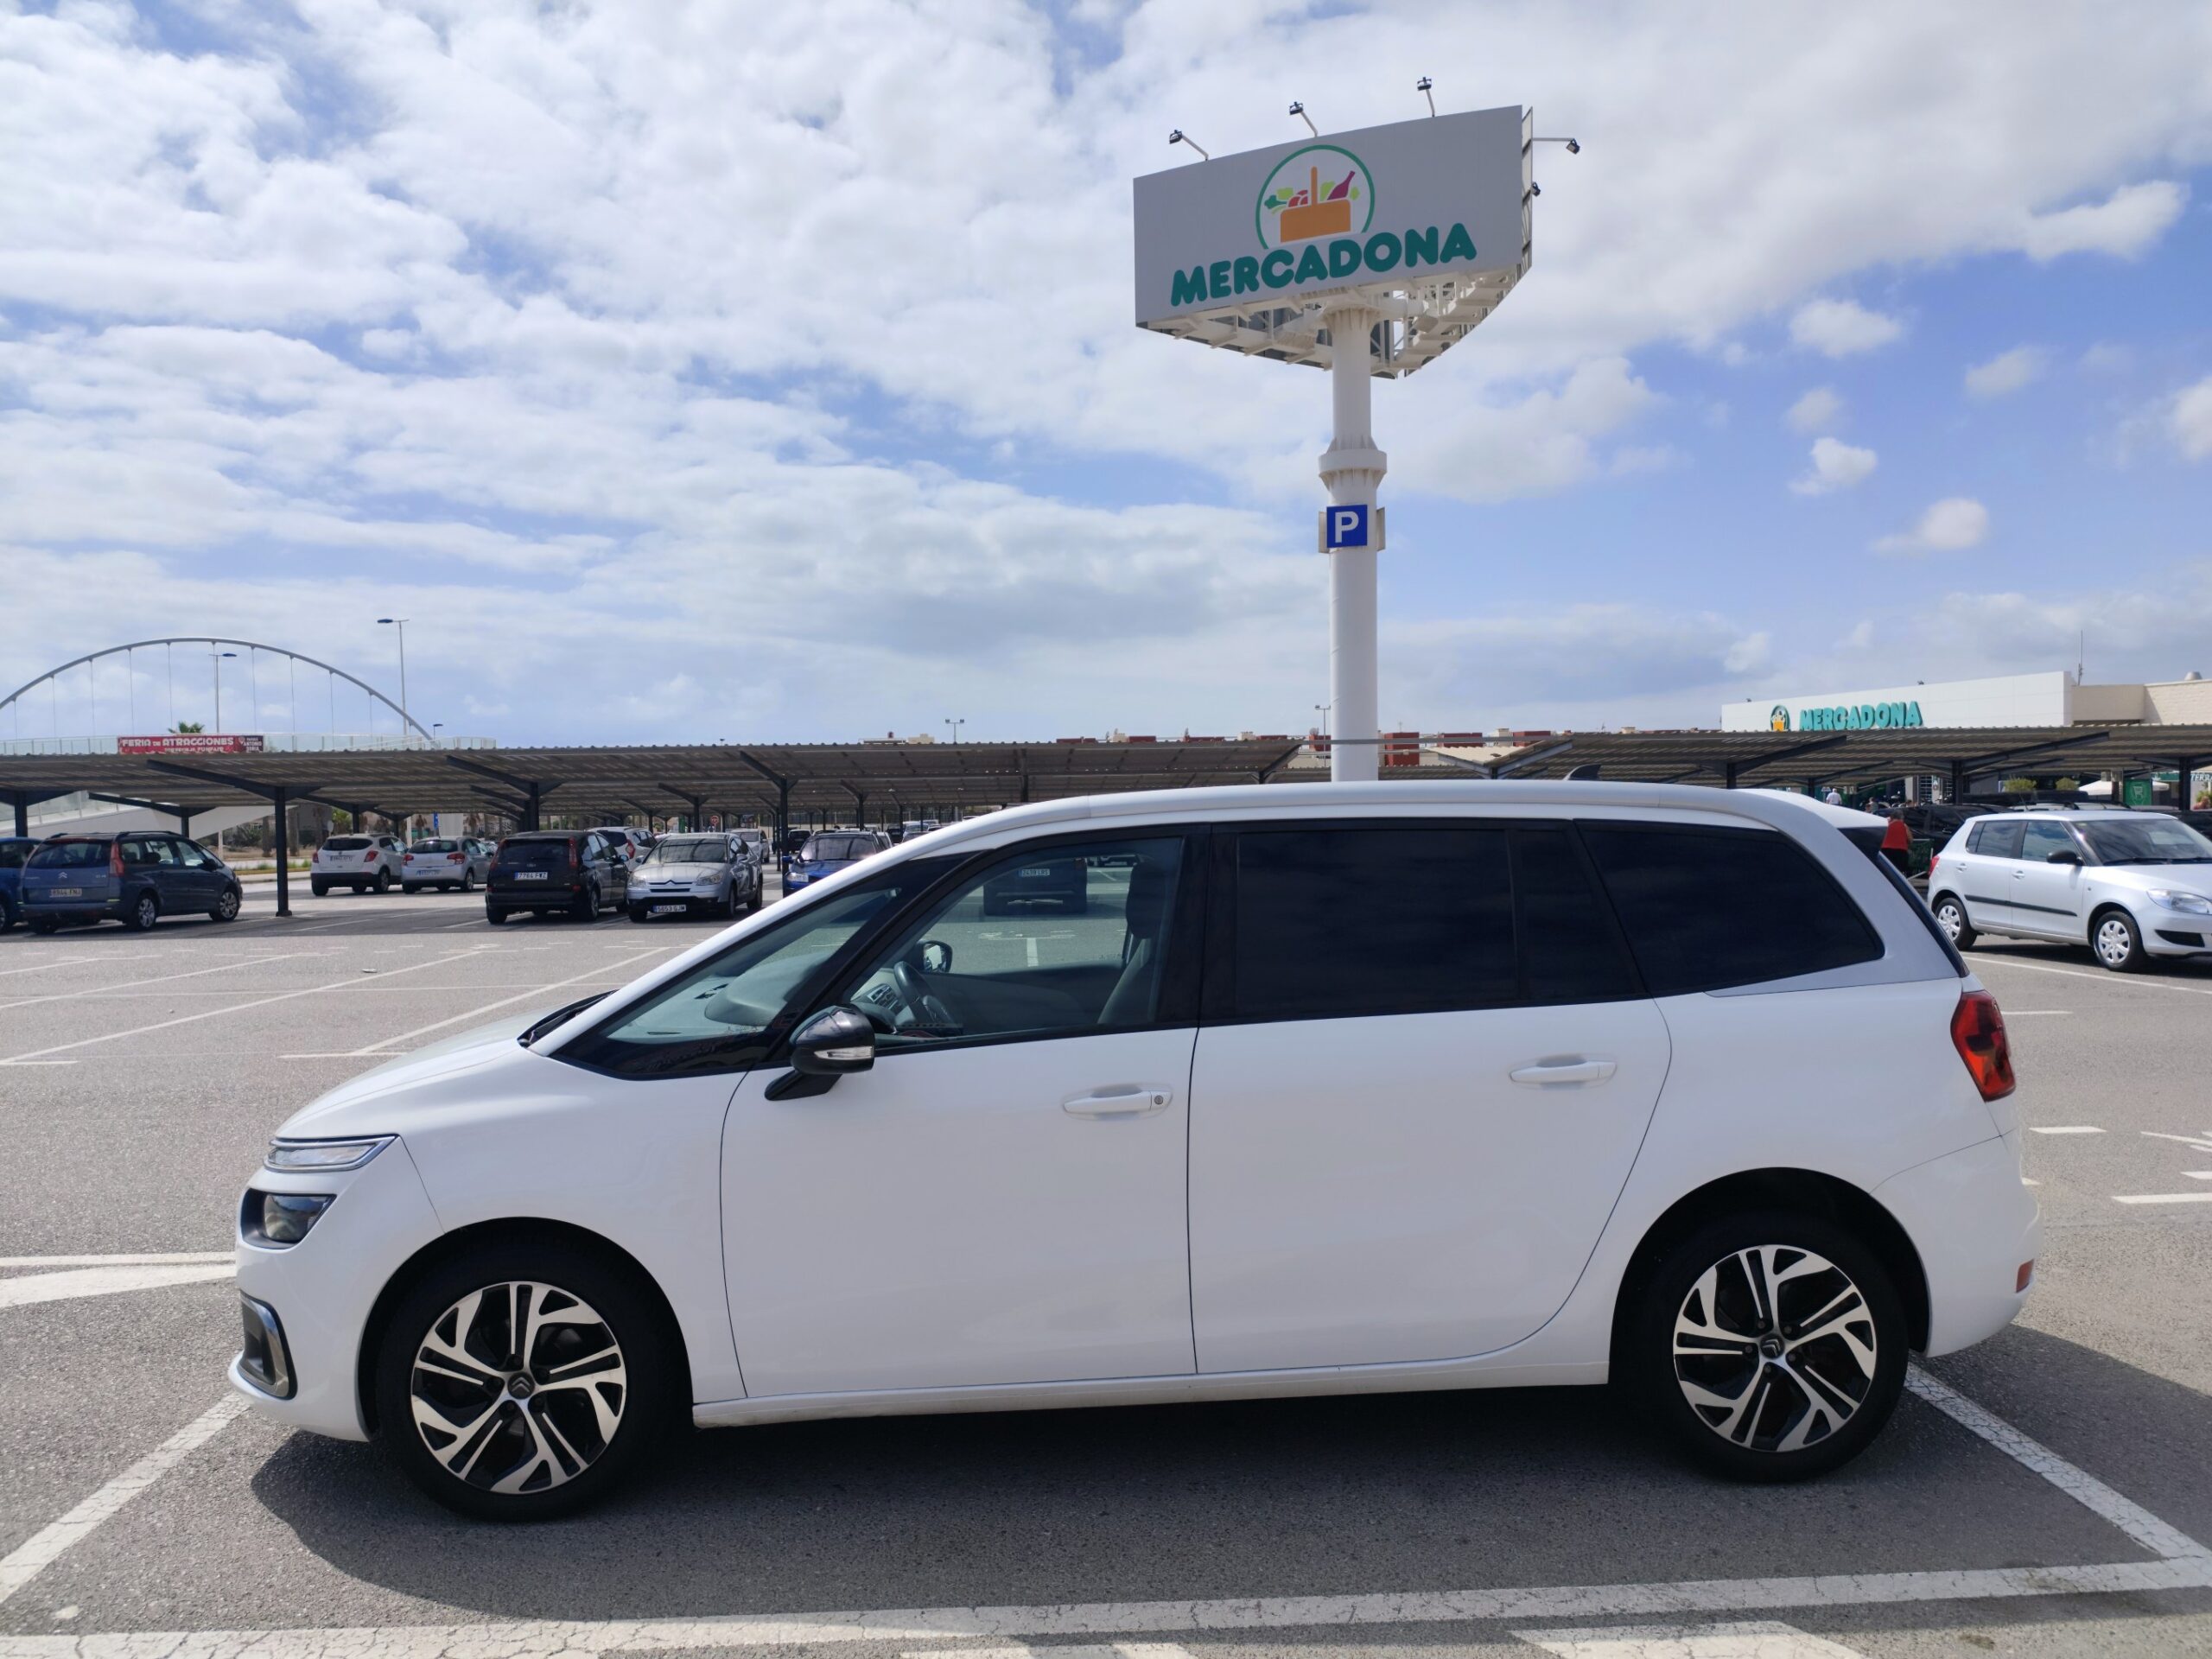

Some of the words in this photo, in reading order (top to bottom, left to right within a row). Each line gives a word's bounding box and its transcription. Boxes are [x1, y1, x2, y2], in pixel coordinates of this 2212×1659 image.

[1170, 222, 1478, 307] MERCADONA
[1334, 511, 1359, 543] P
[1799, 701, 1924, 731] MERCADONA
[162, 737, 234, 747] ATRACCIONES
